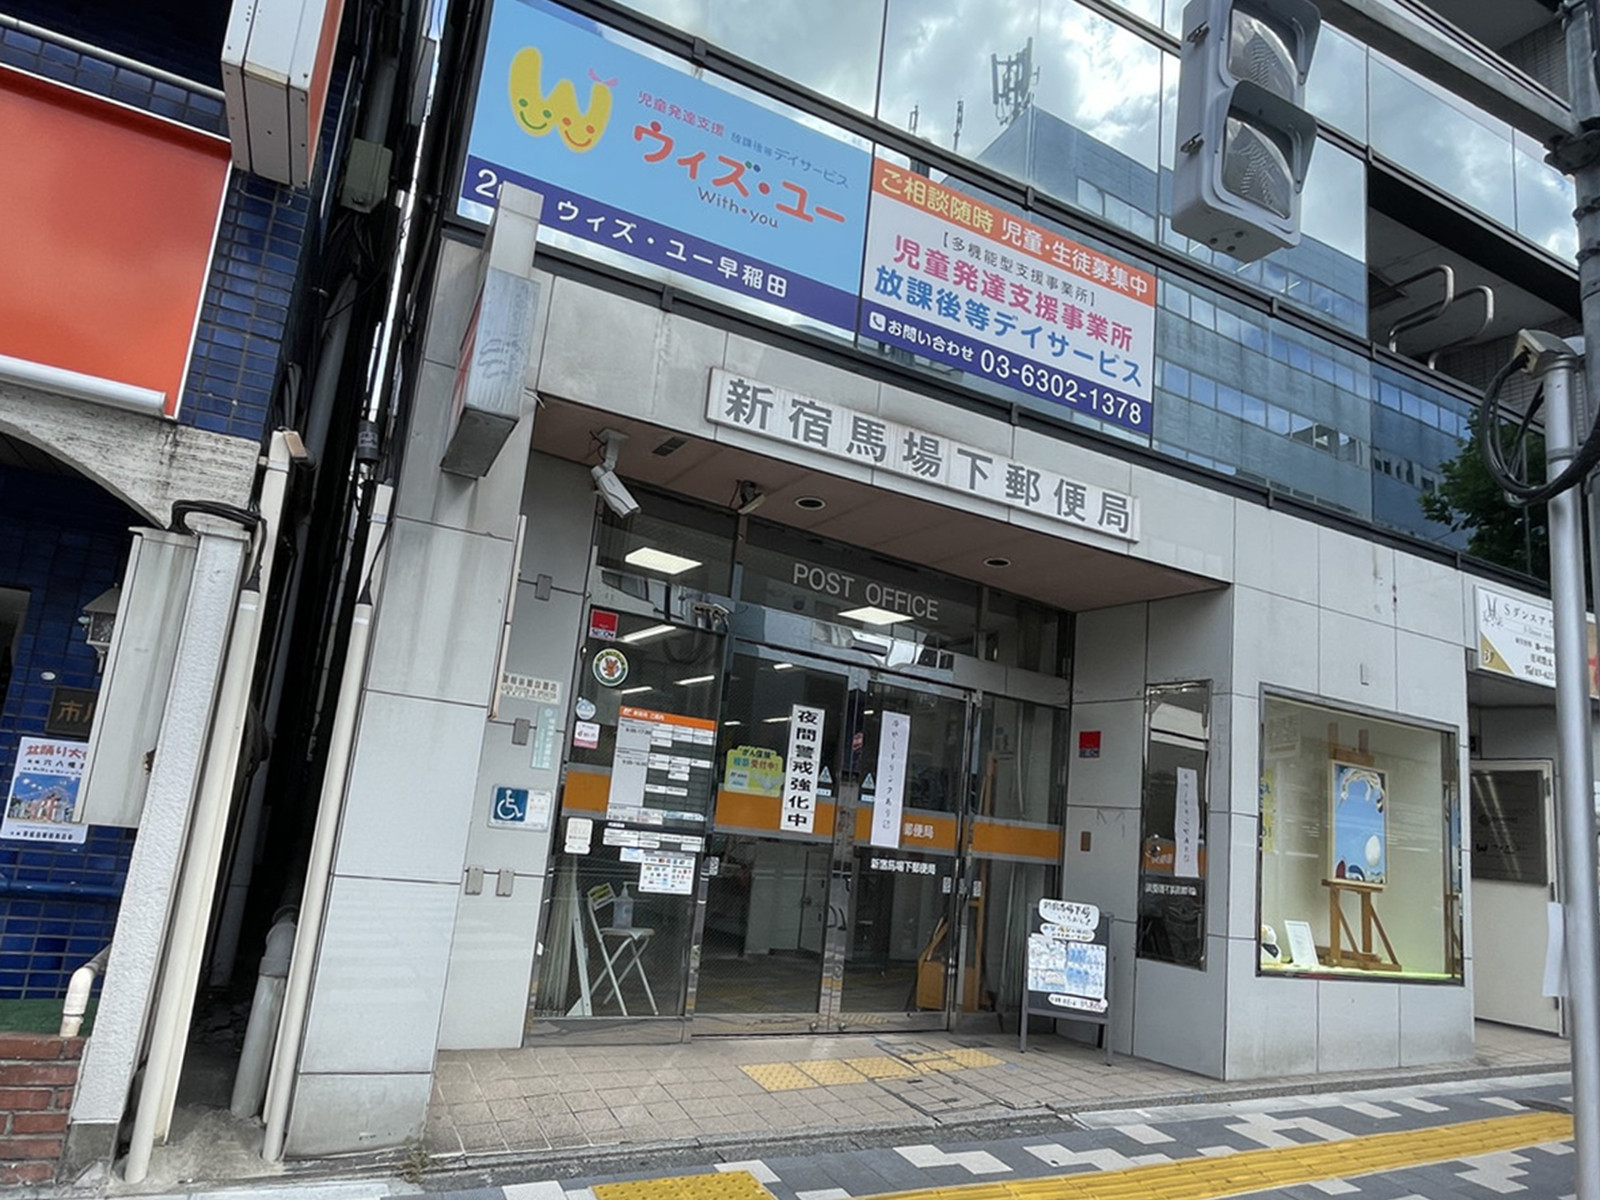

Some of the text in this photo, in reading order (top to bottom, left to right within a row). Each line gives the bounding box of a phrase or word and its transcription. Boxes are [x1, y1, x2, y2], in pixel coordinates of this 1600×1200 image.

[638, 90, 725, 136] 児童発達支援
[634, 120, 846, 223] ウィズ・ユー
[557, 200, 788, 299] ウィズ・ユー早稲田
[881, 168, 1148, 298] ご相談随時 児童・生徒募集中
[874, 264, 1143, 388] 放課後等デイサービス
[893, 234, 1133, 352] 児童発達支援事業所
[888, 318, 1142, 425] お問い合わせ 03-6302-1378
[725, 377, 1131, 534] 新宿馬場下郵便局
[793, 562, 940, 622] POST OFFICE
[786, 709, 819, 828] 夜間警戒強化中
